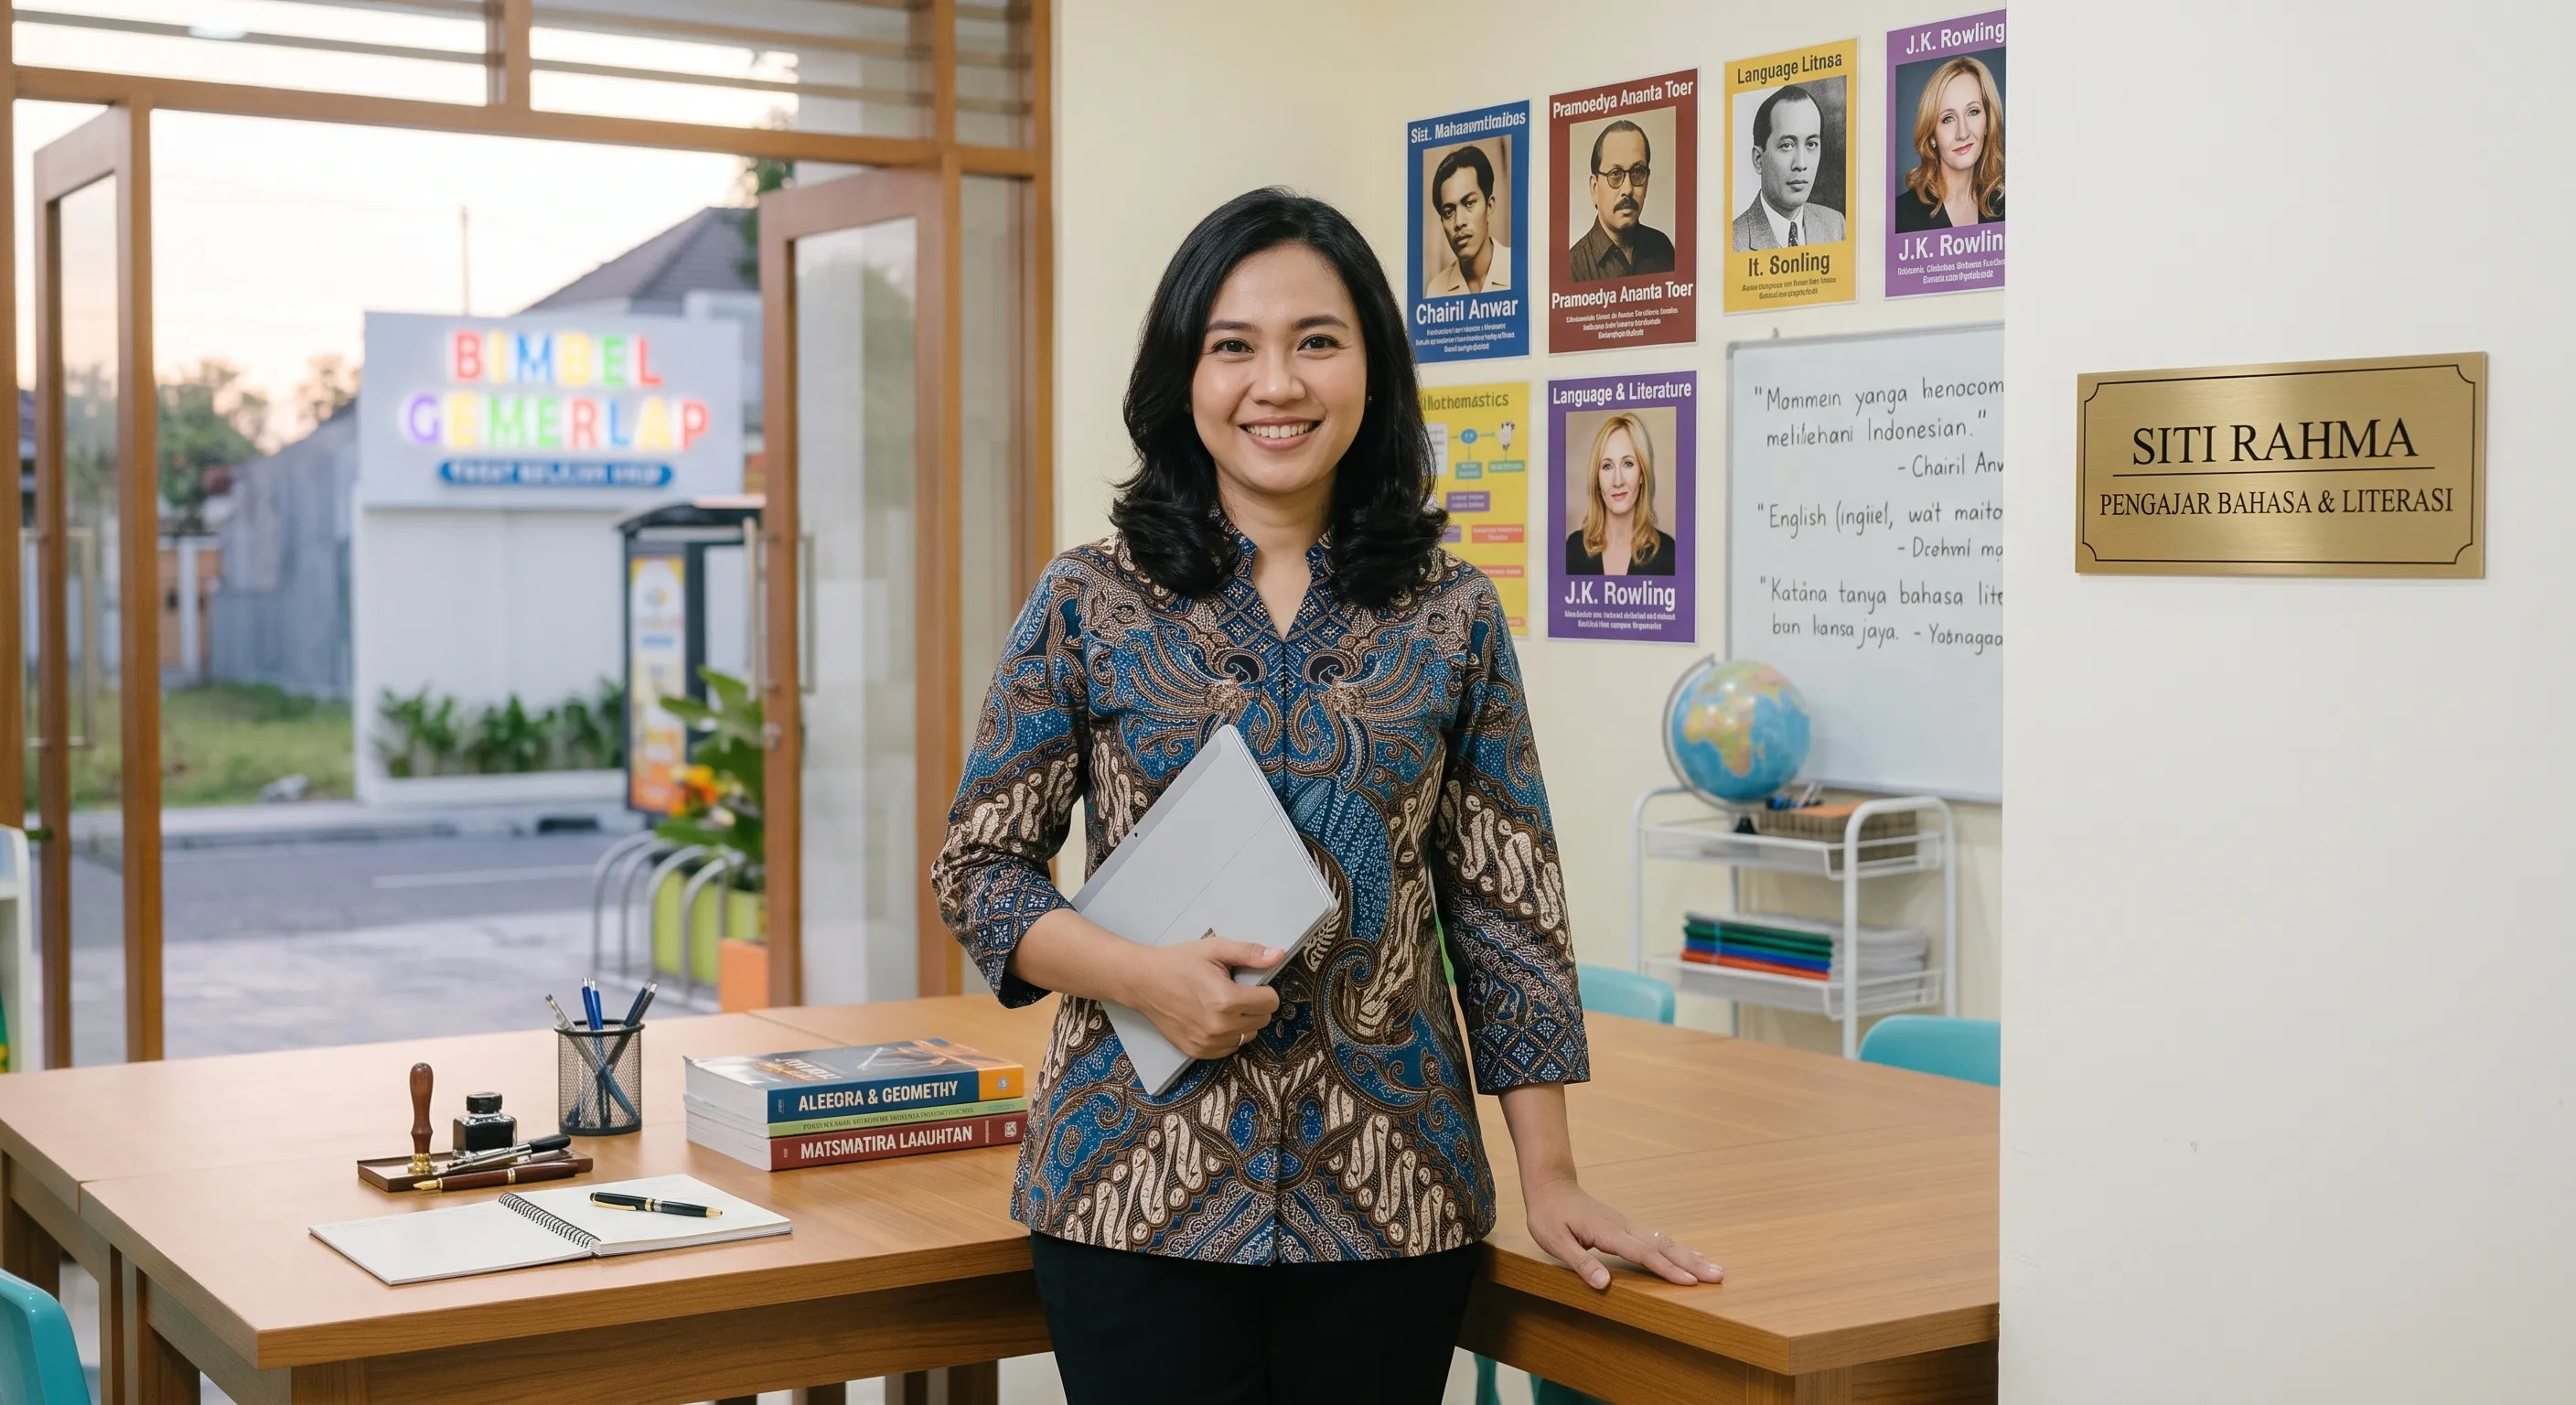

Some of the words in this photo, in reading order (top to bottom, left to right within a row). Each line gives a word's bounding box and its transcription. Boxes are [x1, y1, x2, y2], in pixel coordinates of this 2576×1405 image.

[1905, 31, 1937, 55] J.K.
[1940, 22, 2005, 48] Rowling
[1737, 61, 1798, 85] Language
[1552, 93, 1617, 119] Pramoedya
[1620, 84, 1662, 107] Ananta
[1665, 80, 1694, 99] Toer
[1898, 236, 1934, 261] J.K.
[1940, 229, 2005, 257] Rowlin
[1769, 252, 1830, 275] Sonling
[1551, 288, 1617, 309] Pramoedya
[1619, 283, 1662, 303] Ananta
[1665, 281, 1694, 298] Toer
[1415, 300, 1465, 325] Chairil
[1468, 298, 1519, 320] Anwar
[451, 330, 664, 386] BIMBEL
[1552, 387, 1613, 407] Language
[1615, 382, 1626, 401] &
[1628, 381, 1692, 401] Literature
[1854, 389, 1907, 417] yanga
[407, 391, 711, 450] GEMERLAP
[2132, 424, 2218, 466] SITI
[2229, 416, 2420, 463] RAHMA
[1912, 453, 1966, 478] Chairil
[2098, 491, 2213, 517] PENGAJAR
[2217, 489, 2313, 515] BAHASA
[2317, 488, 2336, 514] &
[2341, 487, 2454, 514] LITERASI
[1564, 581, 1599, 605] J.K.
[1604, 580, 1676, 612] Rowling
[1838, 579, 1887, 616] tanya
[1899, 578, 1964, 606] bahasa
[867, 1089, 879, 1105] &
[882, 1080, 959, 1104] GEOMETHY
[800, 1133, 897, 1160] MATSMATIRA
[900, 1125, 973, 1149] LAAUHTAN
